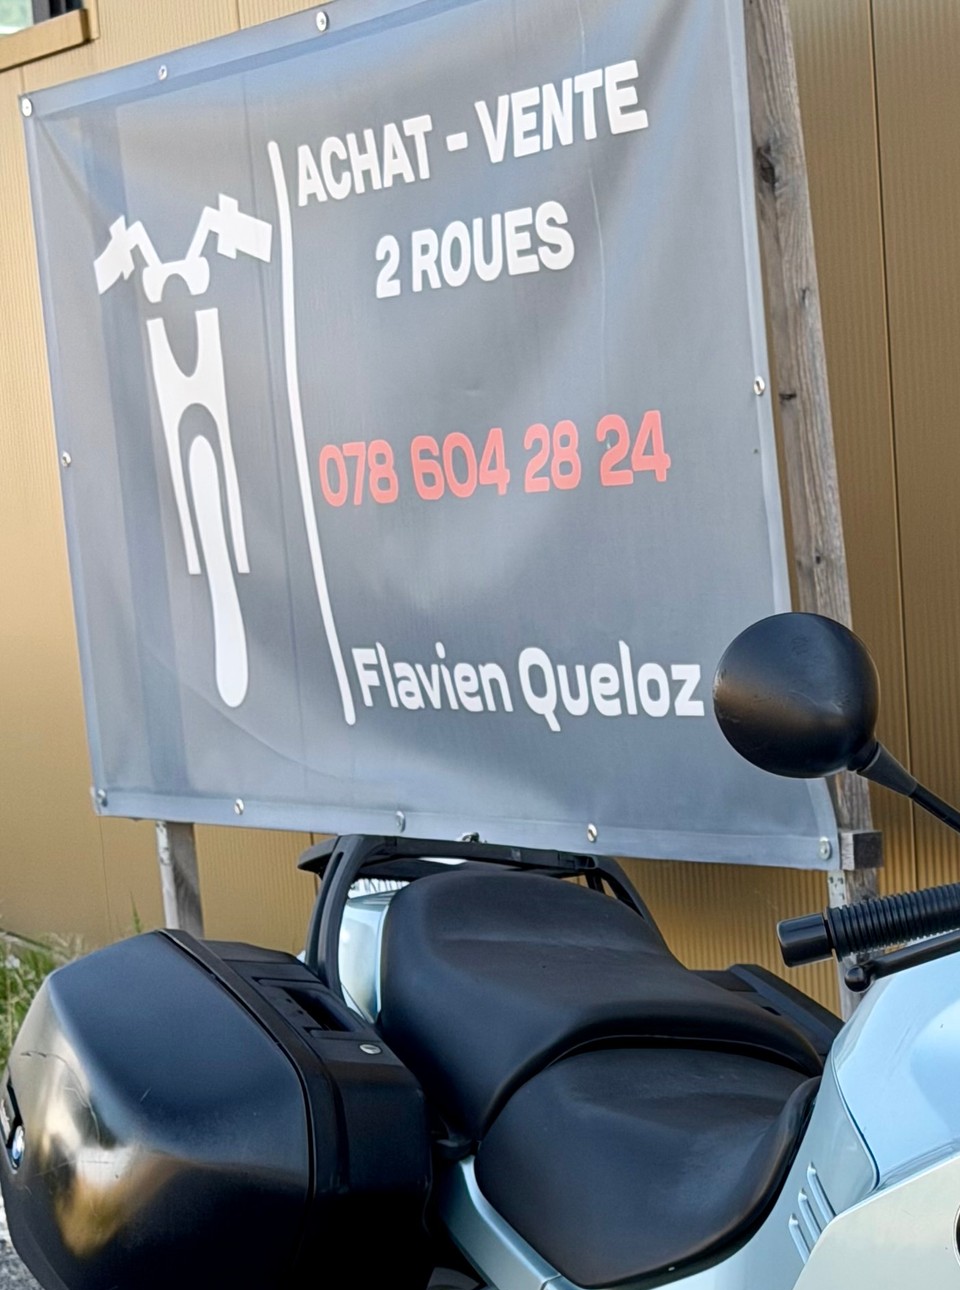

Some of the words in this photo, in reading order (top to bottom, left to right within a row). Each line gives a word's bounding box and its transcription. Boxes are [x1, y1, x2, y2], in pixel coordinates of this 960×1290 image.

[297, 114, 434, 207] ACHAT
[445, 131, 468, 152] -
[475, 60, 650, 164] VENTE
[376, 234, 402, 299] 2
[412, 200, 576, 293] ROUES
[319, 440, 399, 507] 078
[411, 427, 510, 500] 604
[524, 421, 582, 492] 28
[596, 411, 671, 486] 24
[352, 642, 514, 712] Flavien
[518, 640, 706, 732] Queloz
